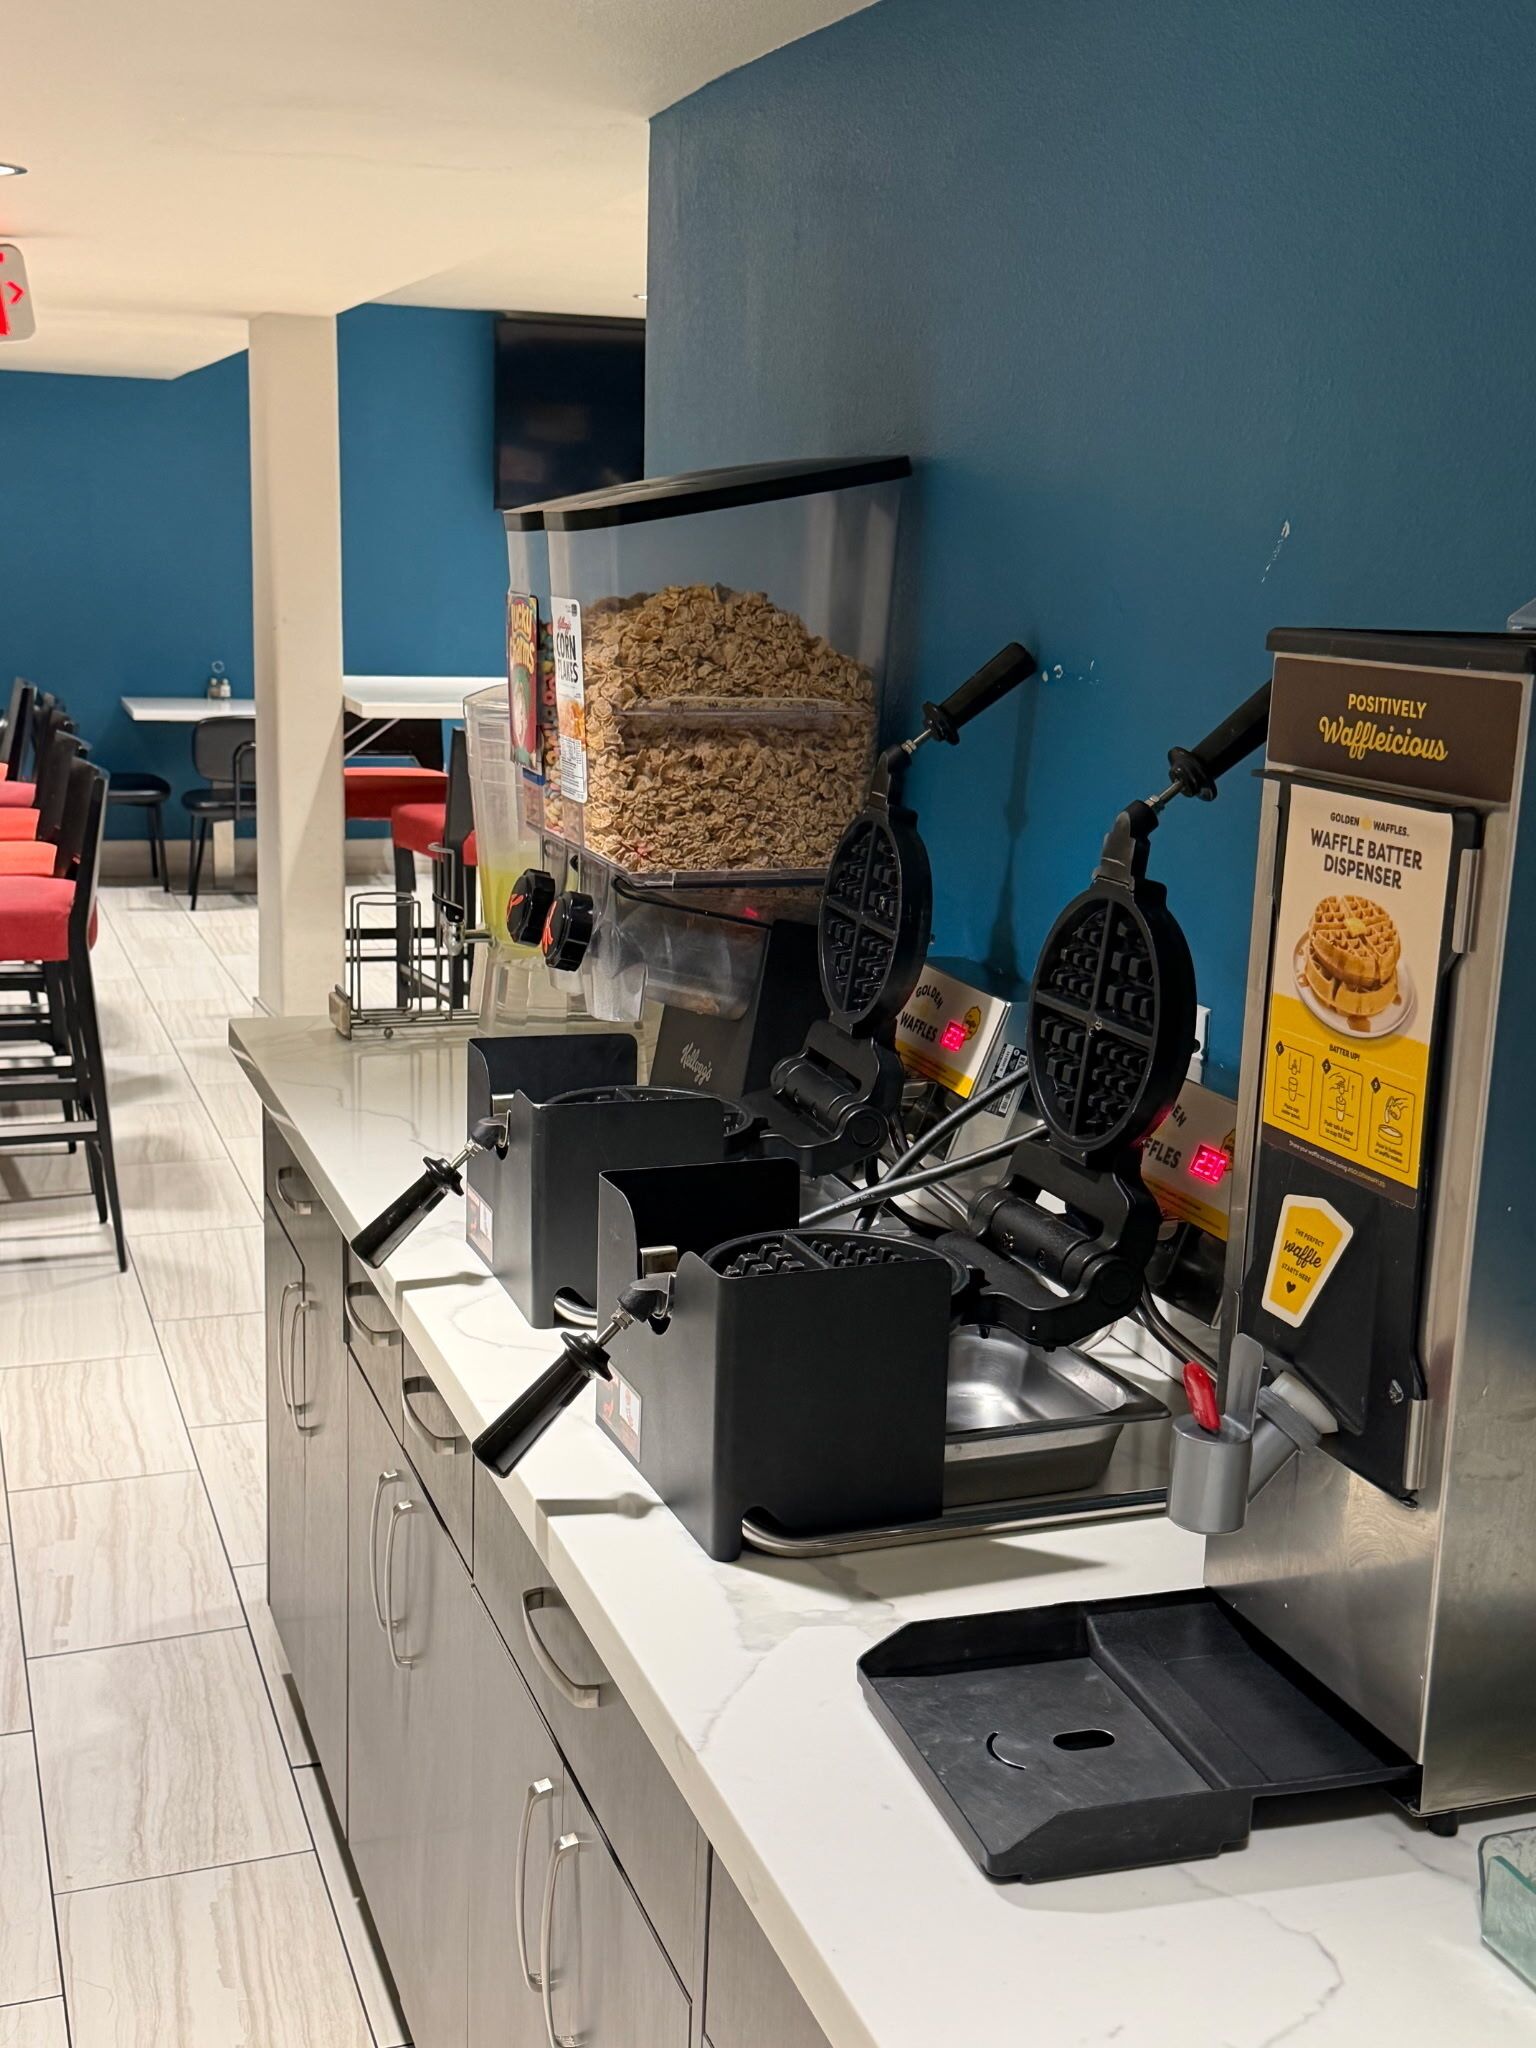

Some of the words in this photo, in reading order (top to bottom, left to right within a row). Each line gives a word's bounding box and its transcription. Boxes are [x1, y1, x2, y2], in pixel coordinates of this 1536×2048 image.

[556, 632, 577, 661] CORN
[558, 658, 579, 683] FLAKES
[1347, 693, 1428, 719] POSITIVELY
[1319, 715, 1449, 761] Waffleicious
[1330, 812, 1360, 827] GOLDEN
[1311, 828, 1365, 857] WAFFLE
[1367, 840, 1423, 870] BATTER
[1323, 854, 1402, 890] DISPENSER
[915, 984, 943, 1009] GOLDEN
[900, 1011, 938, 1042] WAFFLES
[680, 1041, 713, 1086] Kellogg's
[1329, 1044, 1350, 1059] BATTER
[1143, 1137, 1182, 1169] FFLES
[1283, 1239, 1322, 1269] waffle
[1304, 1233, 1325, 1247] PERFECT
[1281, 1262, 1299, 1276] STARTS
